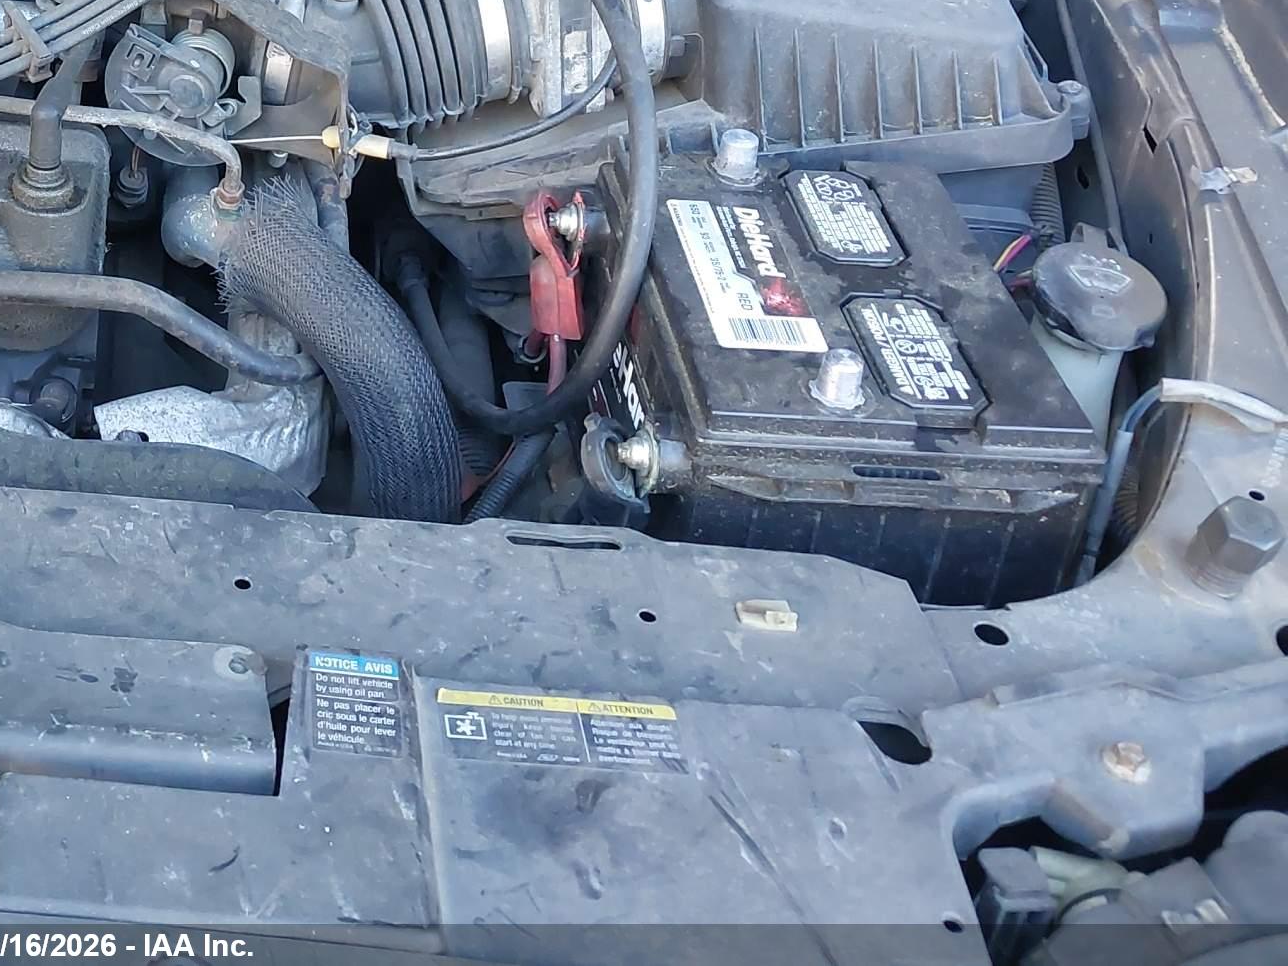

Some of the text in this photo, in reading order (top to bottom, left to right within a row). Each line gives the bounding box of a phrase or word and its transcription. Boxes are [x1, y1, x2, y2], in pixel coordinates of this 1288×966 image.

[733, 206, 786, 278] DieHard
[315, 656, 392, 674] NOTICE AVIS
[316, 673, 328, 682] Do
[331, 676, 345, 684] not
[362, 680, 393, 689] vehicle
[316, 683, 326, 693] by
[329, 686, 353, 696] using
[317, 699, 395, 715] Ne pas placer le
[503, 696, 544, 707] CAUTION
[601, 703, 654, 715] ATTENTION
[317, 710, 395, 726] cric sous le carter
[317, 721, 396, 736] d'huile pour lever
[317, 731, 326, 740] le
